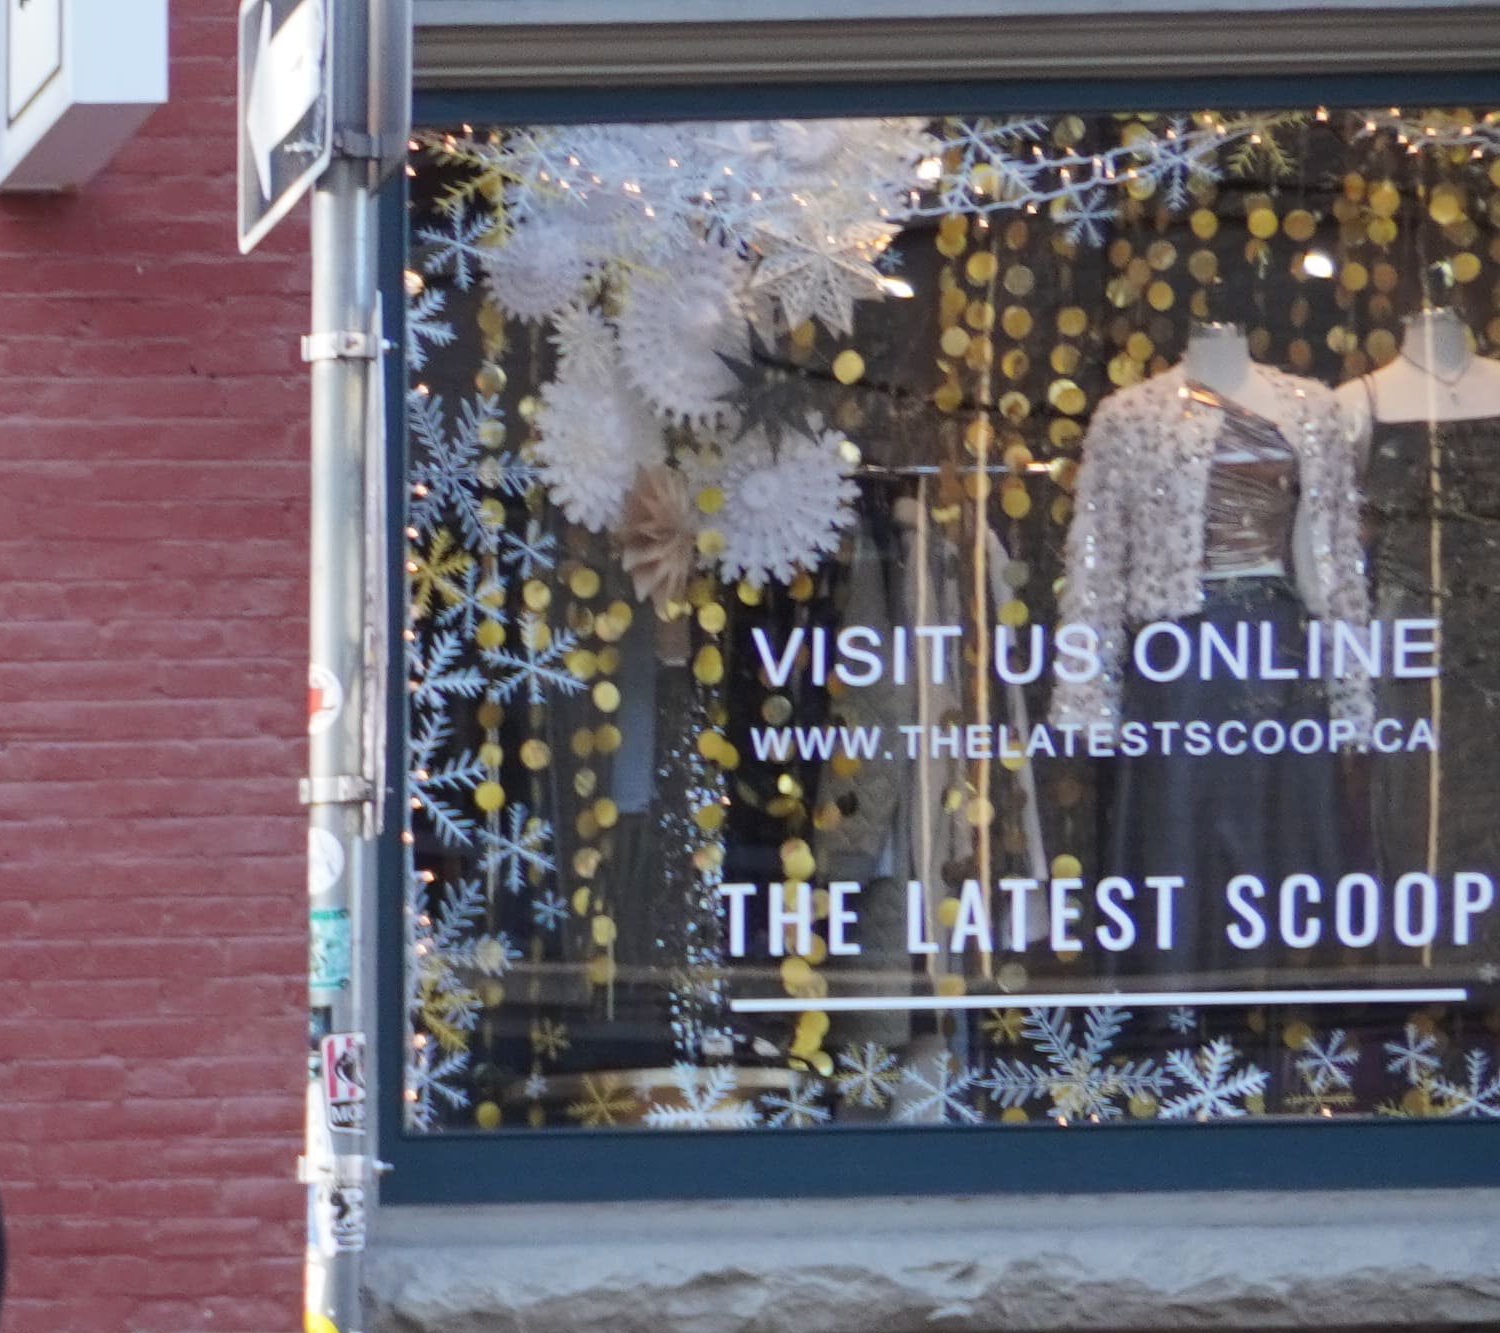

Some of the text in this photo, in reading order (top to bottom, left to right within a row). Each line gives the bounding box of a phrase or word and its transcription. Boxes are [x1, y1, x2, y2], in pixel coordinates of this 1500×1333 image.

[751, 617, 1441, 689] VISIT US ONLINE
[750, 715, 1437, 762] WWW.THELATESTSCOOP.CA
[720, 870, 1494, 958] THE LATEST SCOOP
